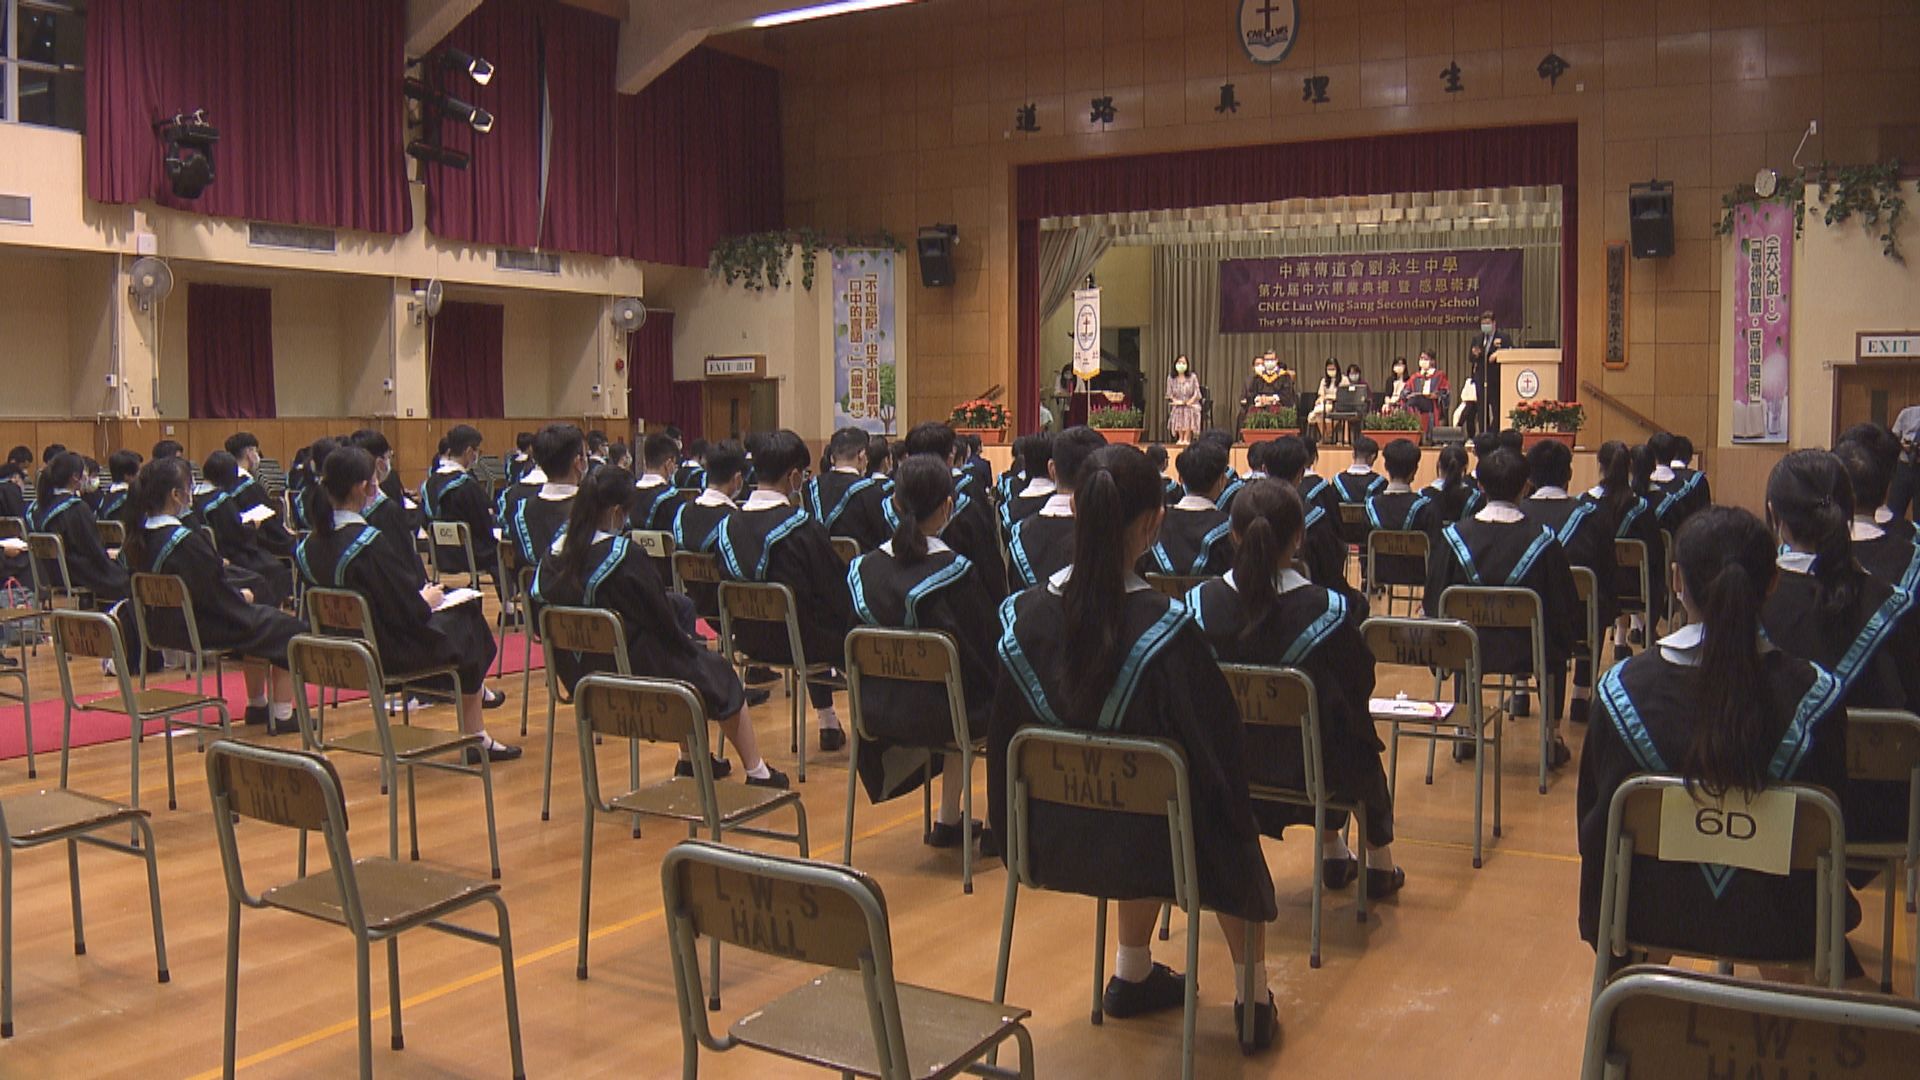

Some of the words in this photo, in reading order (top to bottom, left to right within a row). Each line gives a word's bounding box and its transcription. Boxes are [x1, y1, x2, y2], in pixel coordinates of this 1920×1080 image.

[1279, 256, 1458, 279] 中華傳道會劉永生中學
[1258, 302, 1290, 312] CNEC
[1292, 301, 1313, 312] Lau
[1314, 300, 1345, 313] Wing
[1346, 299, 1375, 312] Sang
[1376, 298, 1438, 311] Secondary
[1439, 296, 1480, 308] School
[1259, 317, 1275, 327] The
[1304, 316, 1337, 328] Speech
[1339, 316, 1357, 327] Day
[1358, 316, 1379, 326] cum
[1381, 314, 1443, 326] Thanksgiving
[1444, 312, 1480, 324] Service
[1868, 340, 1911, 353] EXIT
[710, 362, 731, 372] EXIT
[1396, 645, 1436, 666] HALL
[616, 711, 656, 737] HALL
[1063, 773, 1126, 808] HALL
[1694, 807, 1758, 840] 6D
[731, 906, 807, 959] HALL
